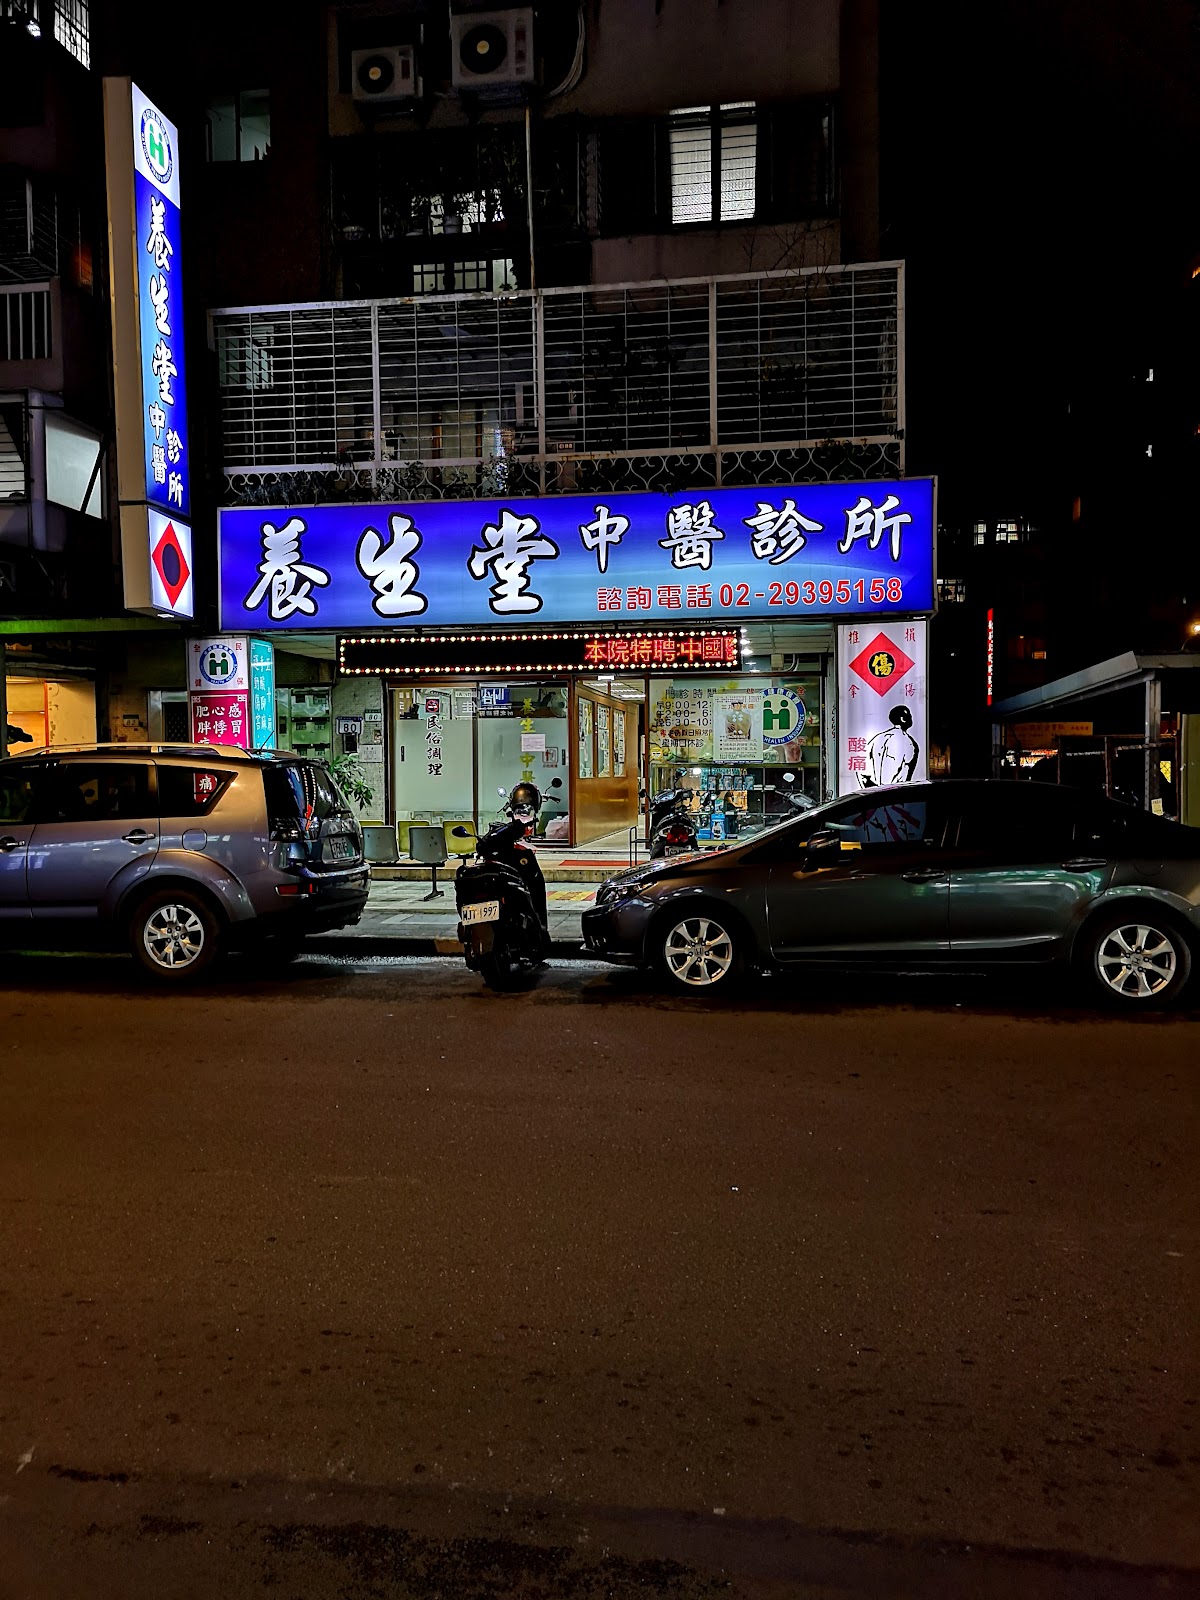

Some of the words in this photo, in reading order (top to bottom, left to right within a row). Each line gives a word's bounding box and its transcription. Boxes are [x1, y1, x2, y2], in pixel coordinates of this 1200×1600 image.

[146, 195, 178, 405] 養生堂
[149, 402, 168, 484] 中醫
[166, 429, 184, 507] 診所
[244, 495, 913, 620] 養生堂中醫診所
[597, 584, 713, 611] 諮詢電話
[719, 577, 903, 608] 02-29395158
[343, 723, 357, 734] 80
[425, 714, 443, 776] 民俗調理
[847, 737, 867, 771] 酸痛
